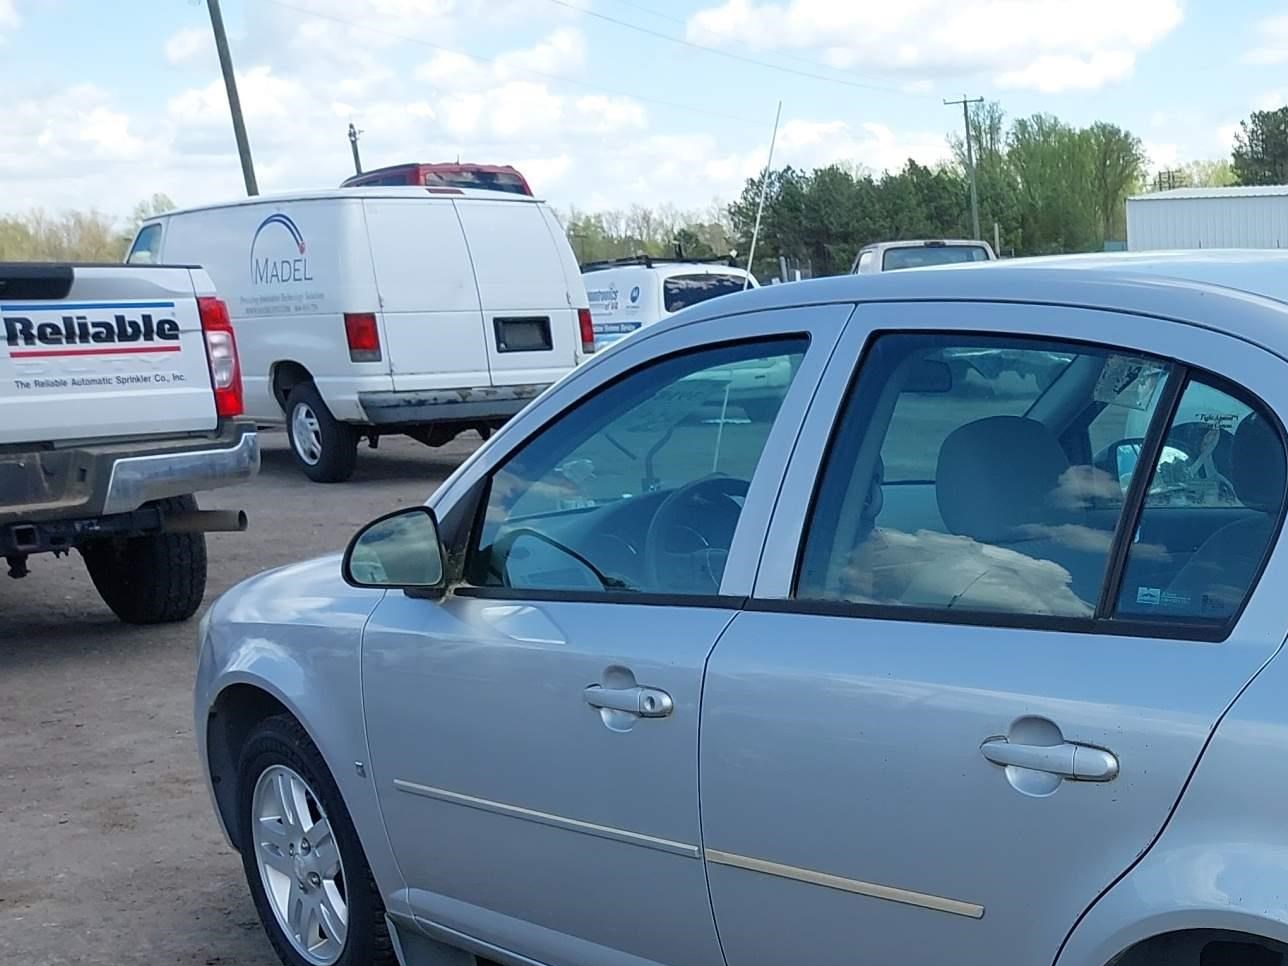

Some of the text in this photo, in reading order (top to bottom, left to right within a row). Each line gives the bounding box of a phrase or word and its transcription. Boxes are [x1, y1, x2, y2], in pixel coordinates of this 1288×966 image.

[255, 258, 313, 285] MADEL
[3, 314, 180, 346] Reliable
[14, 379, 31, 389] The
[34, 378, 68, 389] Reliable
[71, 376, 113, 387] Automatic
[115, 374, 151, 386] Sprinkler
